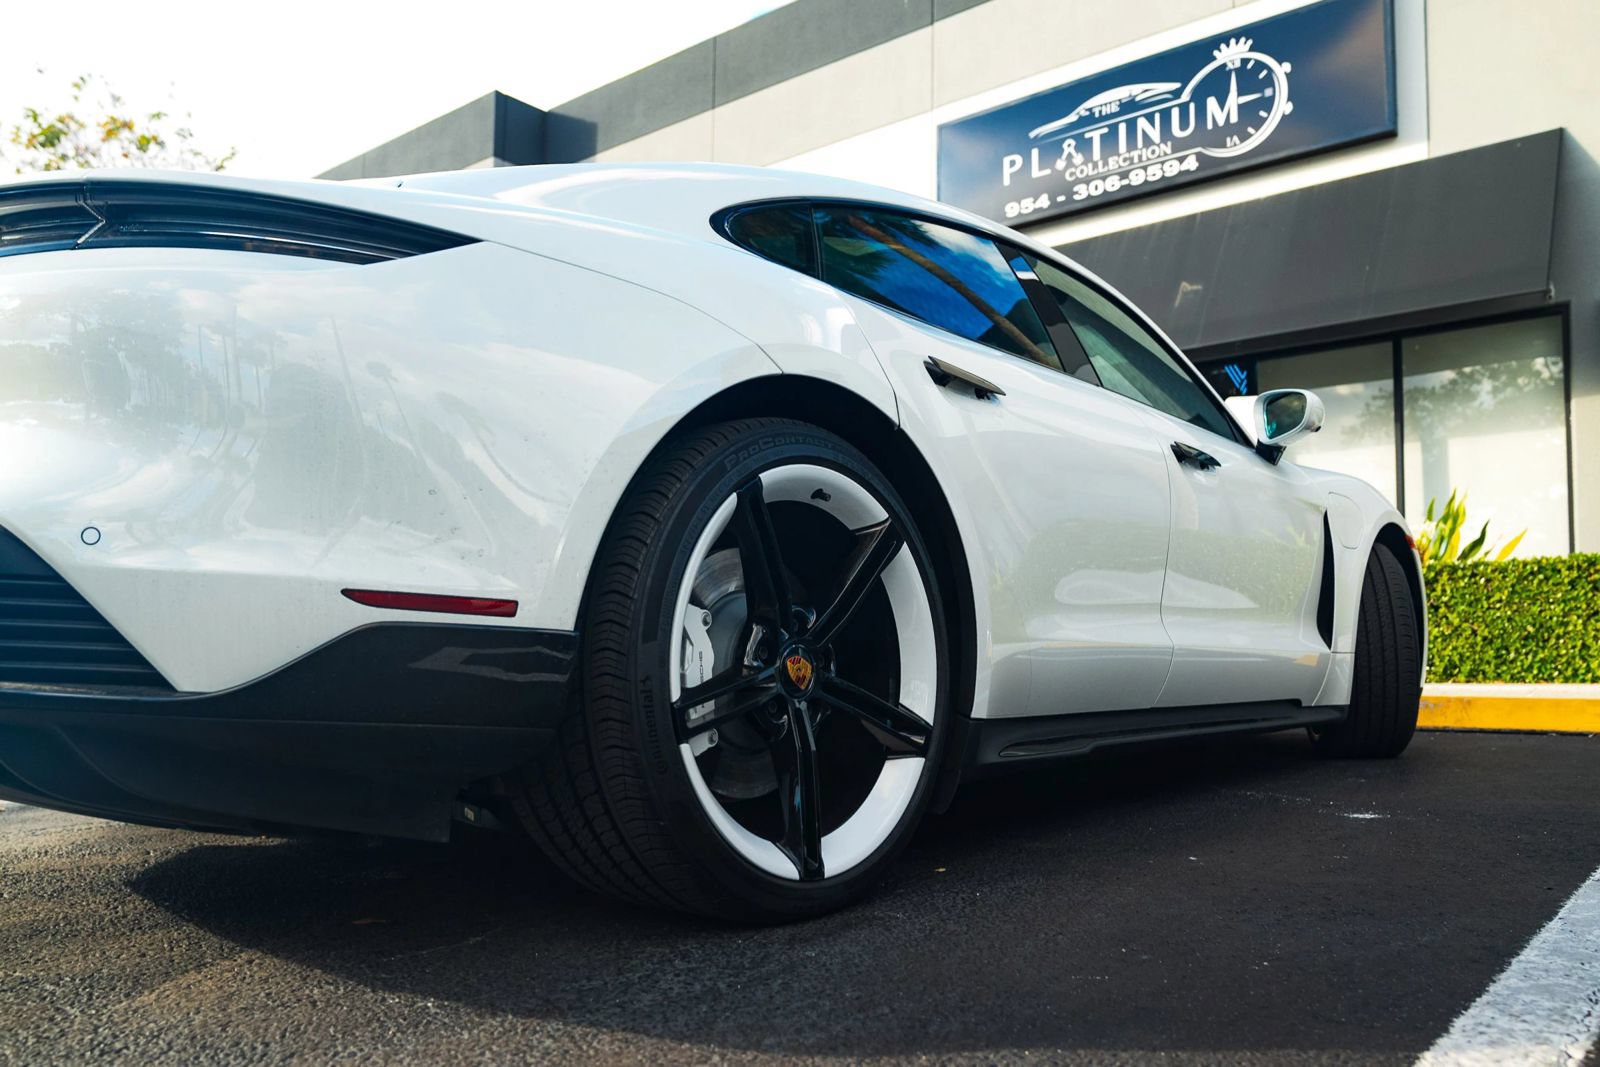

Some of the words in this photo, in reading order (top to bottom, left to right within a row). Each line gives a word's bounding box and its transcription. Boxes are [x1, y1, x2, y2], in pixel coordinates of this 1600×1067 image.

[1091, 100, 1121, 118] THE
[1002, 95, 1239, 187] PLATINUM
[1064, 141, 1173, 182] COLLECTION
[1004, 193, 1051, 218] 954
[1072, 154, 1199, 201] 306-9594
